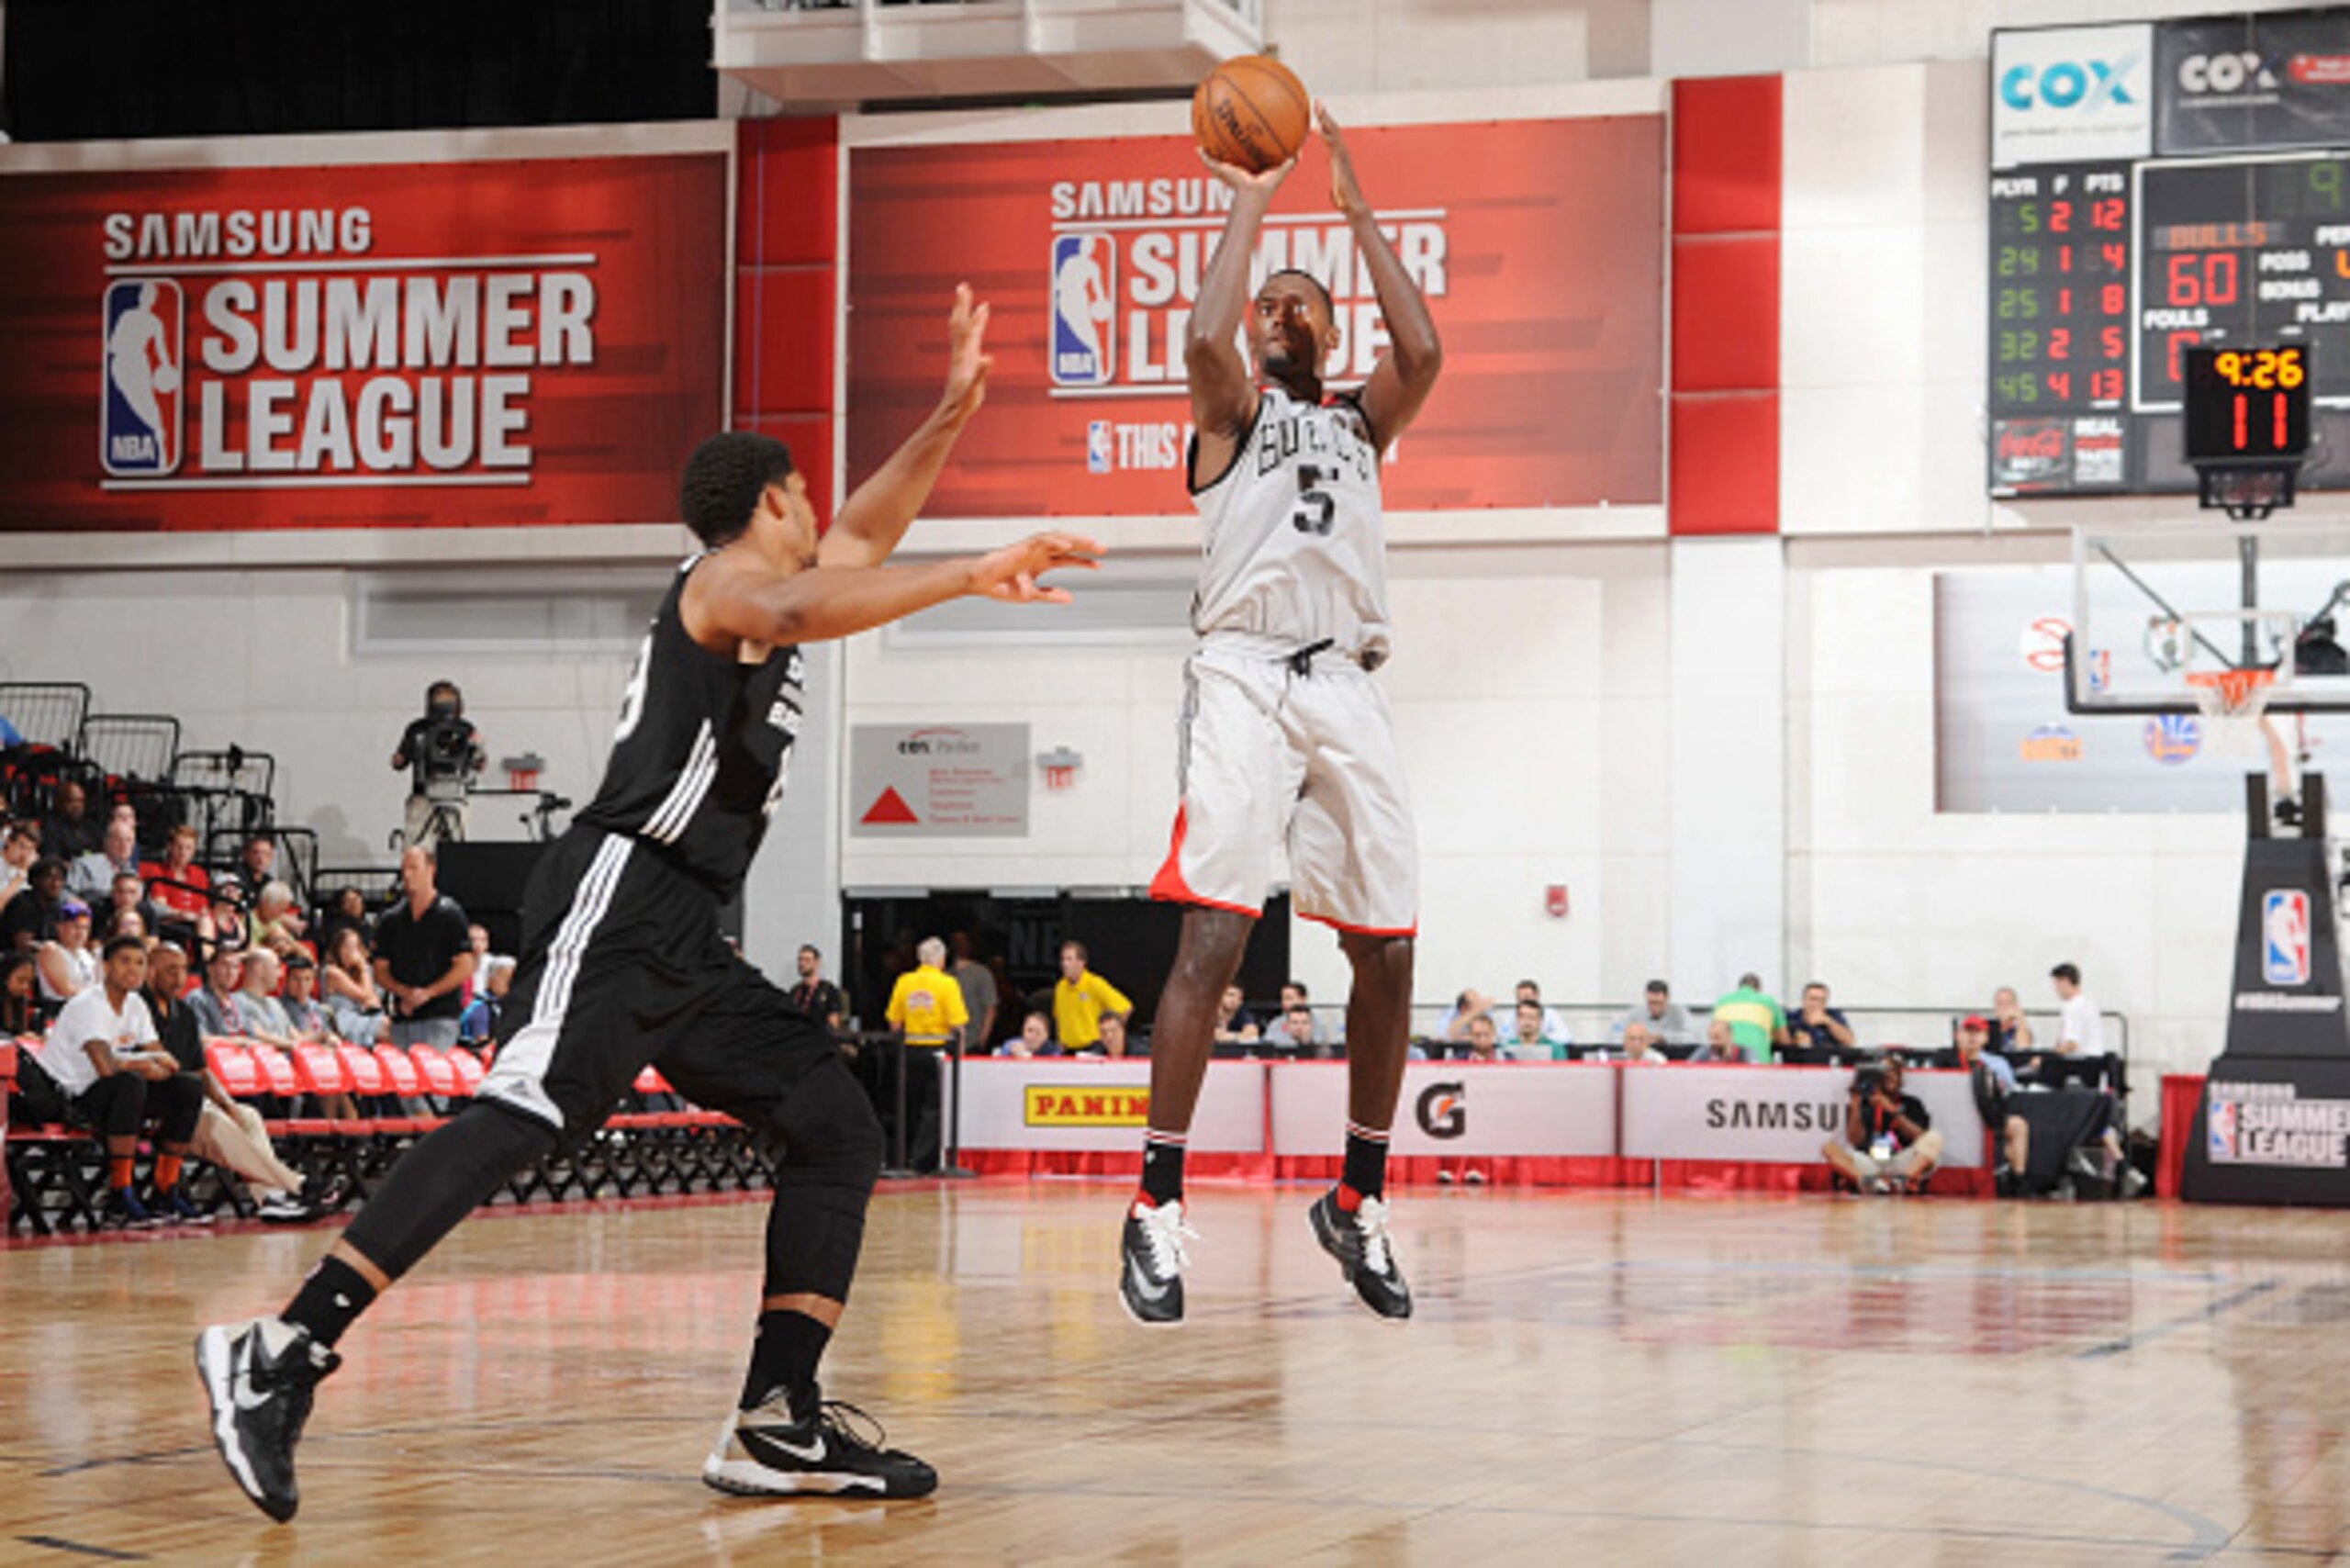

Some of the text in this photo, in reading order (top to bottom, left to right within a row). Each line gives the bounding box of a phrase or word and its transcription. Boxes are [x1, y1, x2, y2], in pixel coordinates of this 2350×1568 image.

[2000, 53, 2143, 114] COX
[1051, 178, 1235, 218] SAMSUN
[2019, 197, 2125, 232] 5 2 12
[104, 207, 371, 260] SAMSUNG
[2169, 222, 2267, 250] BULLS
[1998, 242, 2125, 276] 24 1 4
[2167, 252, 2237, 306] 60
[1998, 284, 2125, 319] 25 1 8
[202, 273, 596, 372] SUMMER
[2048, 328, 2071, 360] 2
[2101, 325, 2124, 359] 5
[2047, 372, 2070, 400] 4
[2090, 368, 2123, 399] 13
[2214, 350, 2303, 389] 9:26
[199, 374, 532, 471] LEAGUE
[2233, 392, 2288, 449] 11
[111, 435, 155, 461] NBA
[1115, 423, 1177, 469] THIS
[1292, 465, 1338, 536] 5
[1035, 1095, 1151, 1116] PANIN
[1416, 1081, 1465, 1139] G
[1706, 1099, 1851, 1132] SAMSU
[2242, 1104, 2350, 1132] SUMME
